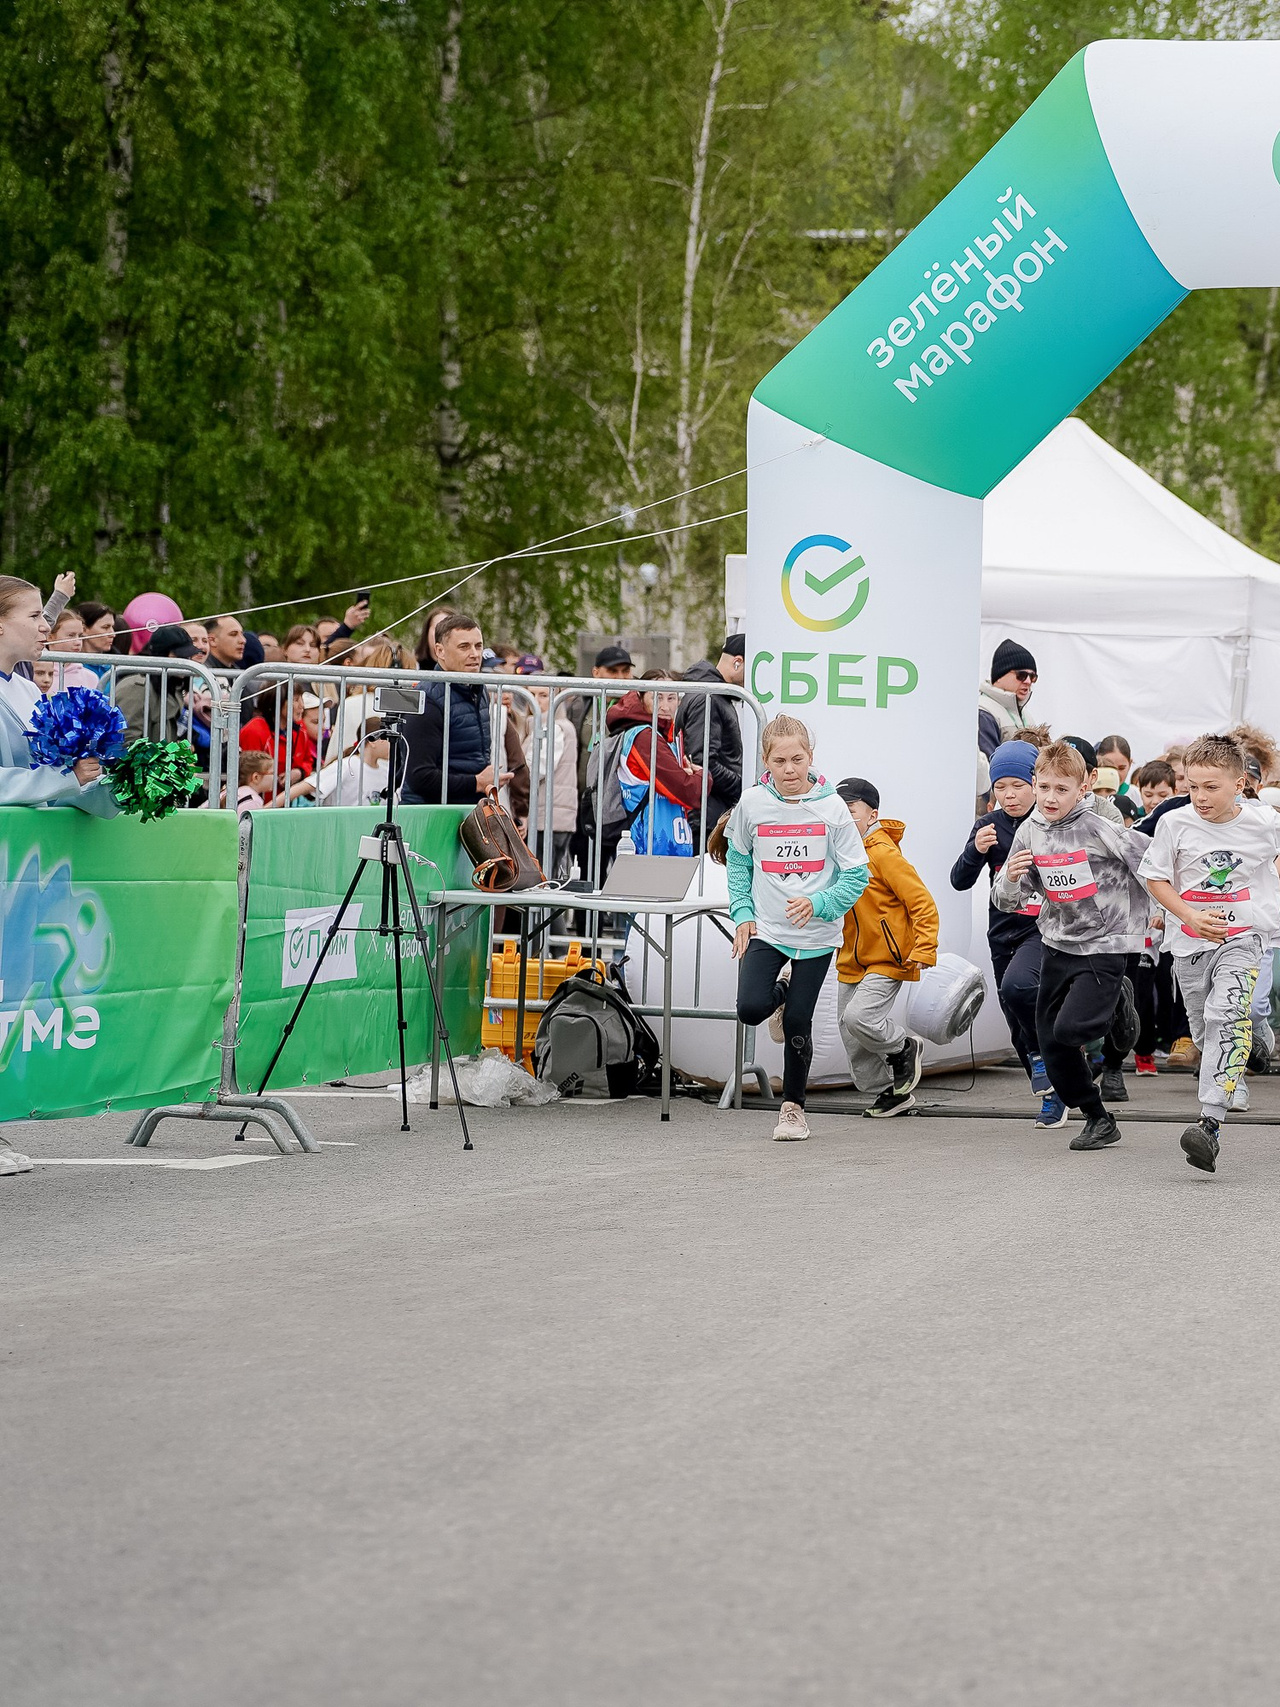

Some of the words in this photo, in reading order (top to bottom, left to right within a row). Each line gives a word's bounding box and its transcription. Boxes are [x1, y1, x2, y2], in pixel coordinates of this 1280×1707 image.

[866, 185, 1038, 369] зелёный
[893, 226, 1069, 404] марафон
[751, 651, 919, 709] СБЕР
[776, 845, 808, 858] 2761
[1047, 874, 1077, 887] 2806
